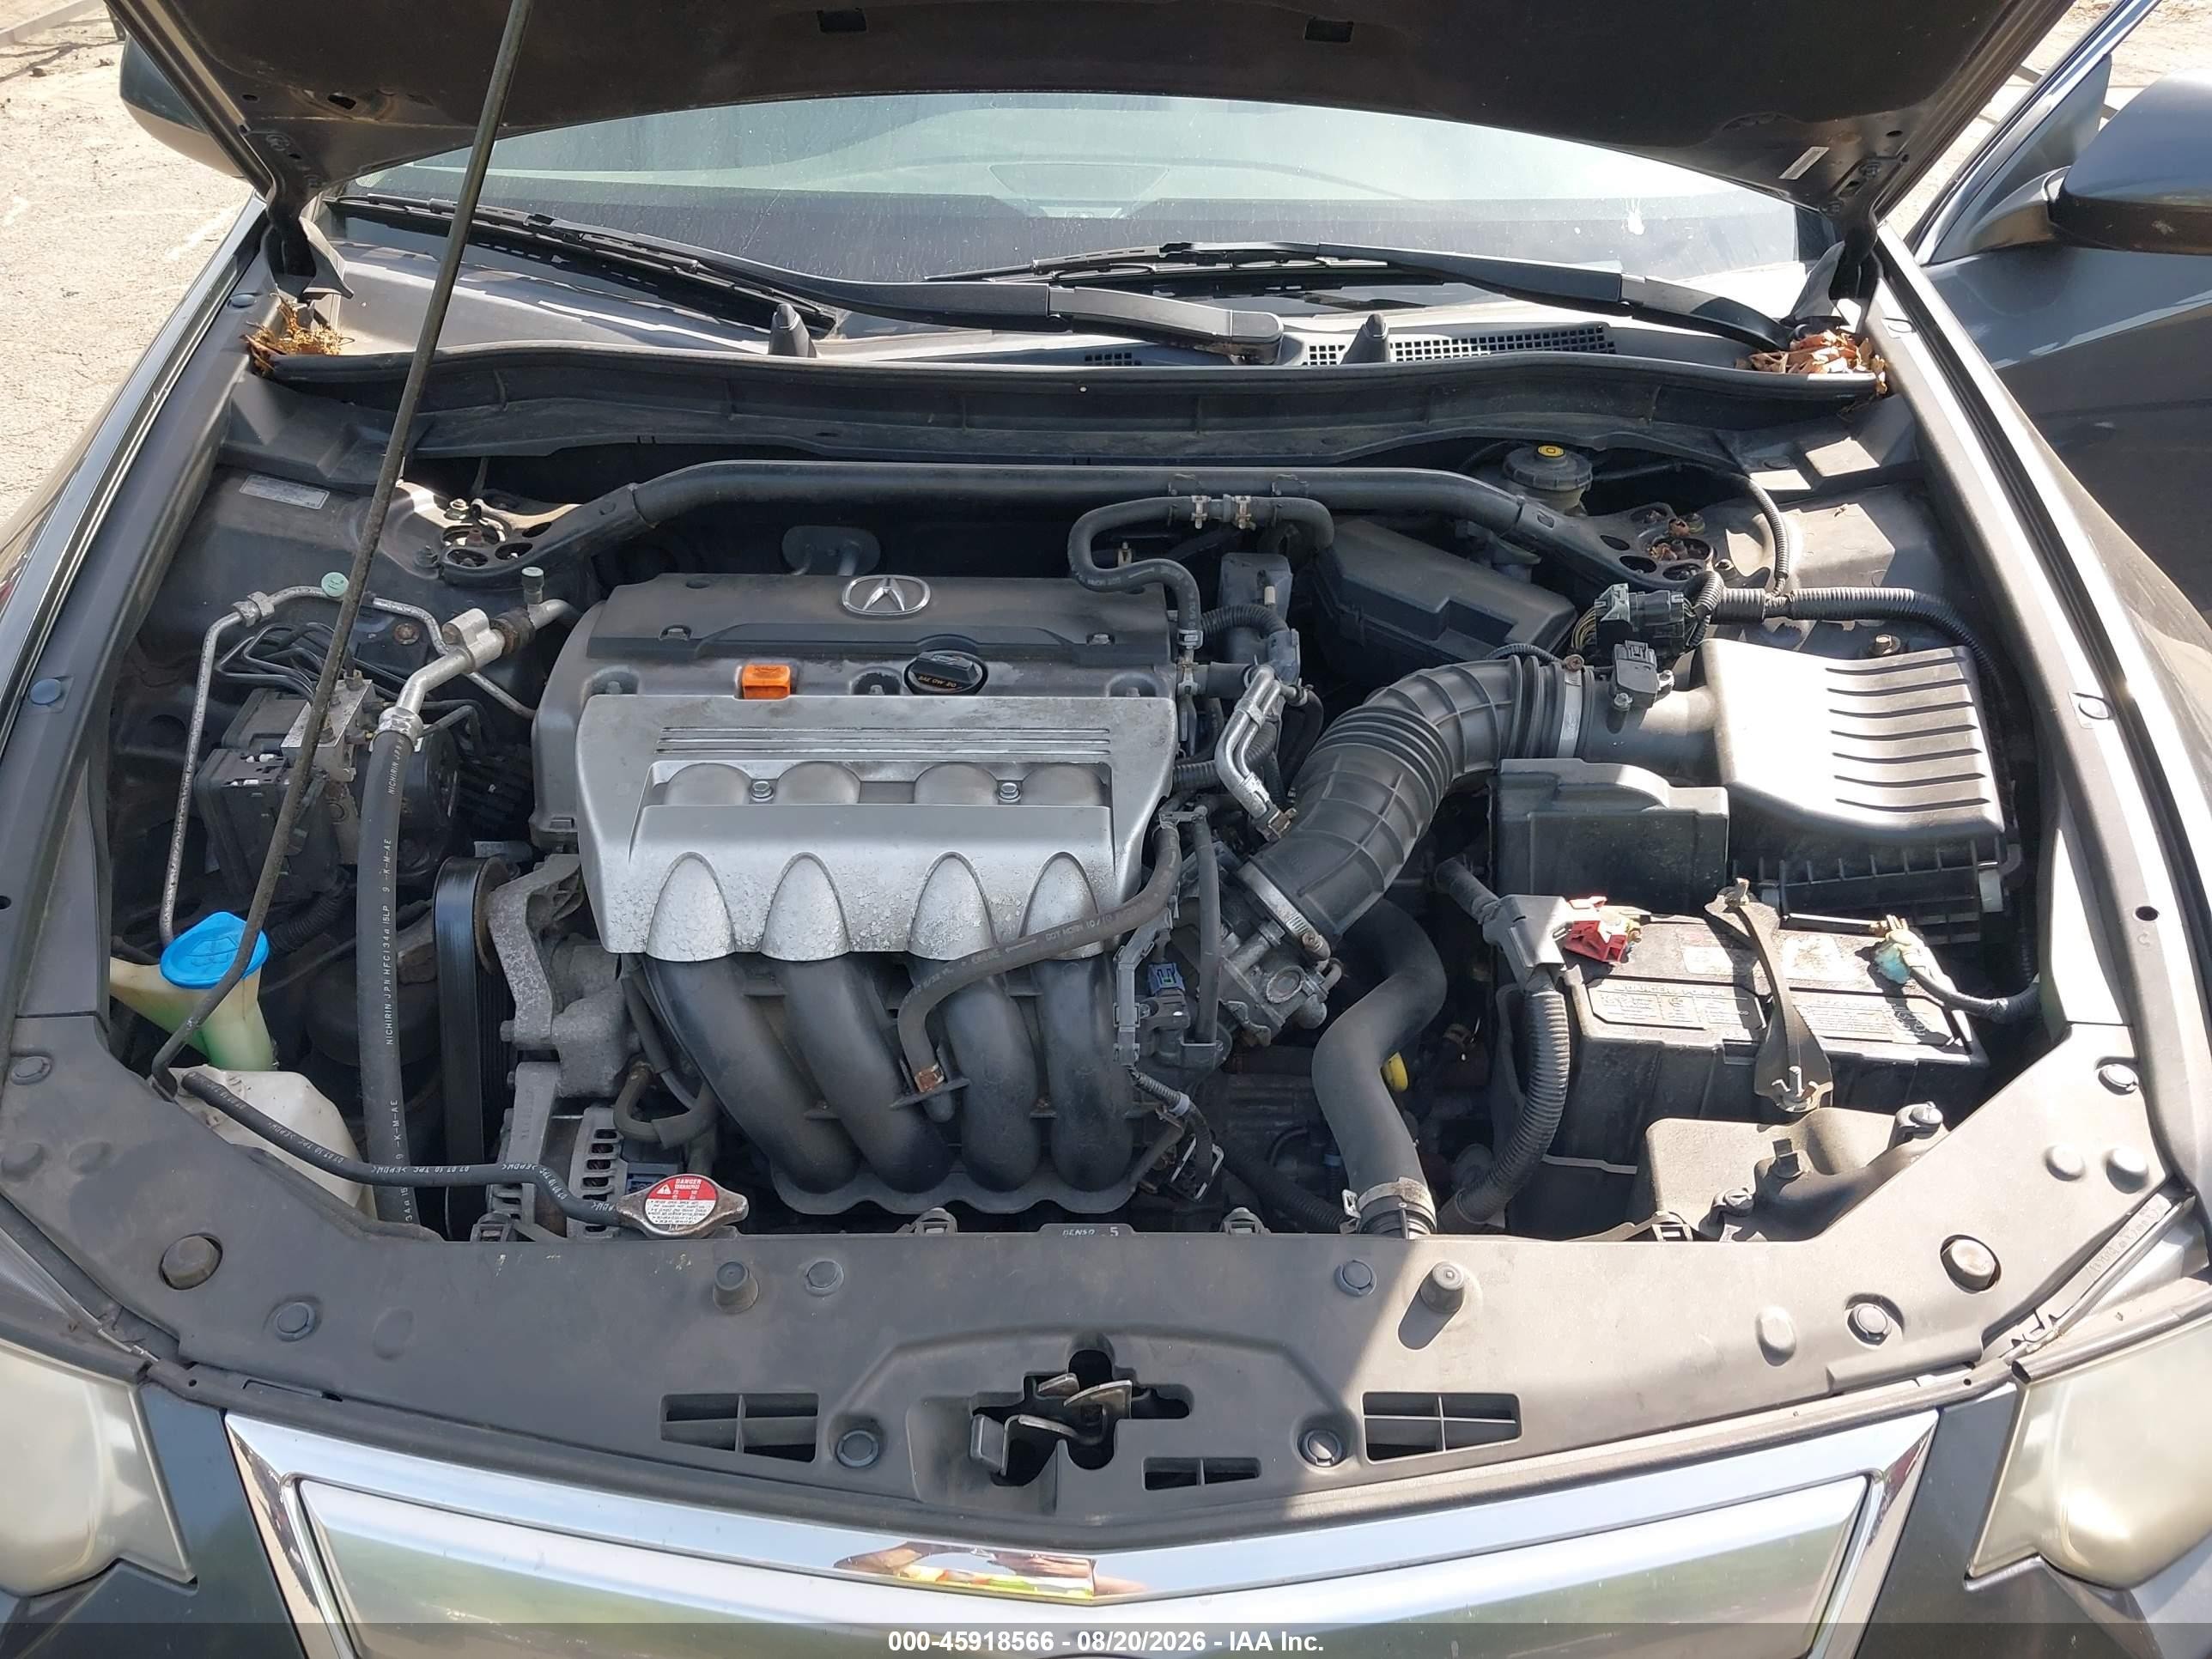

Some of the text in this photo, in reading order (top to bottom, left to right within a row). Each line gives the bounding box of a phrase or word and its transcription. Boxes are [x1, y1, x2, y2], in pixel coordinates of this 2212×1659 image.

[388, 761, 399, 795] NICHIRIN
[382, 928, 392, 975] HFC134a
[383, 979, 392, 999] JPN
[384, 1003, 394, 1045] NICHIRIN
